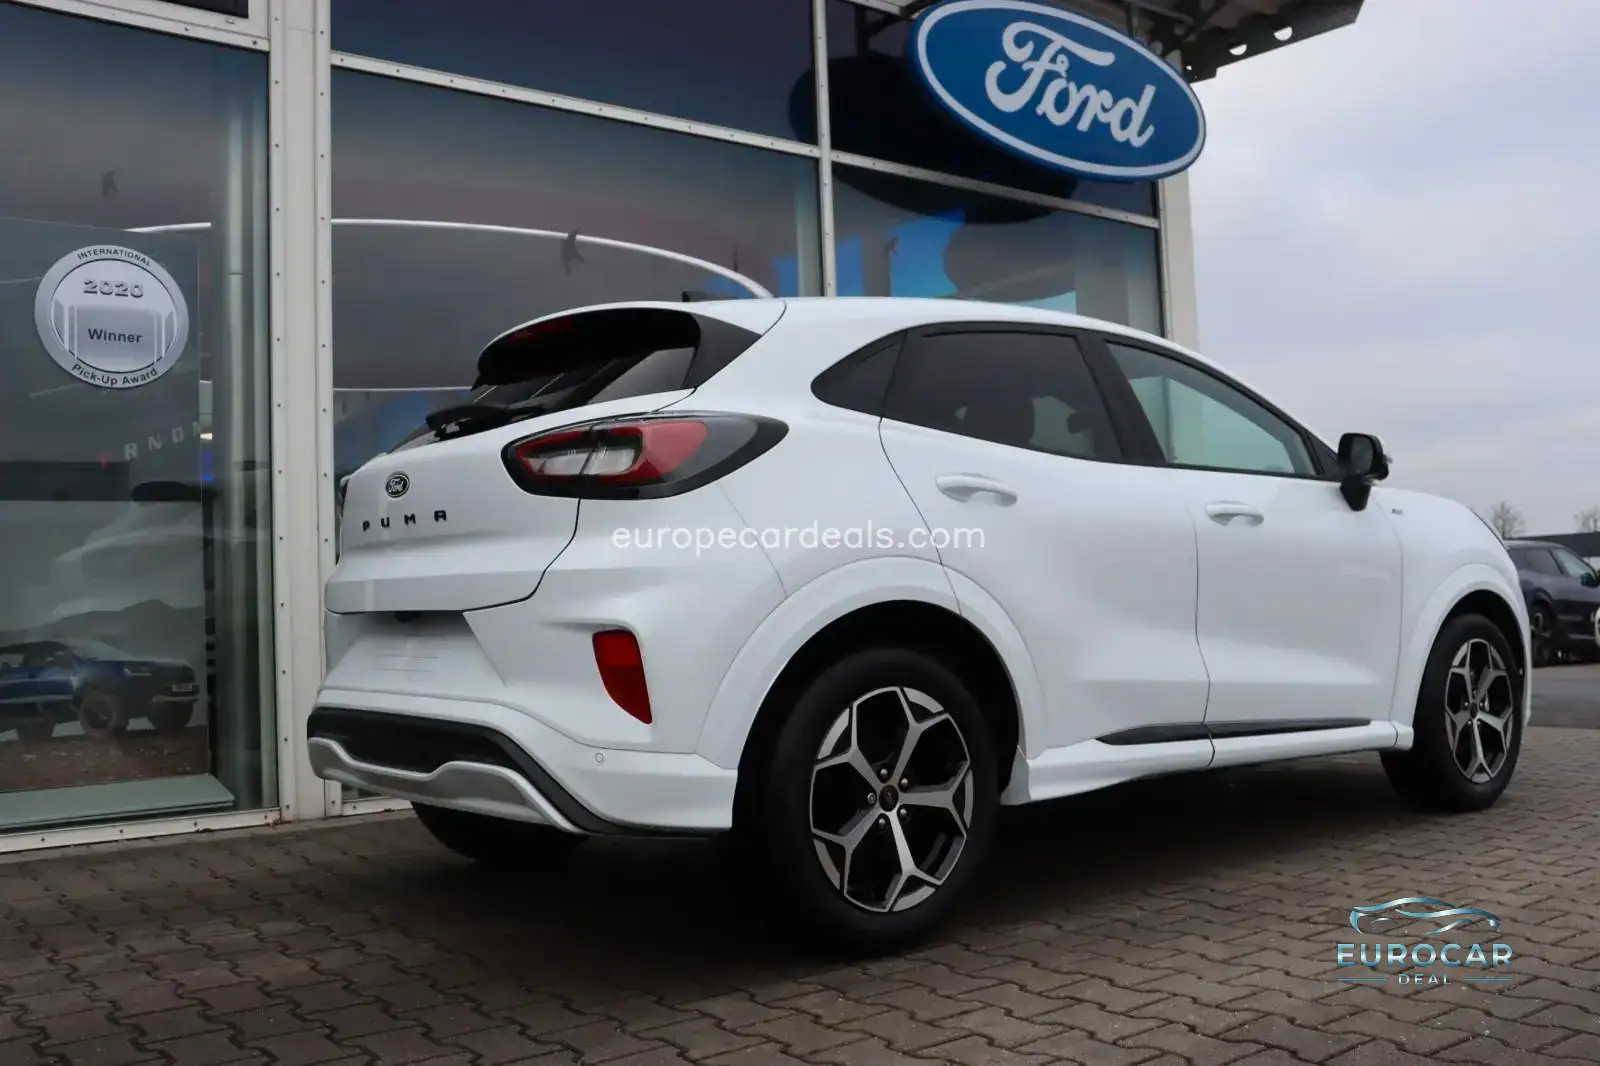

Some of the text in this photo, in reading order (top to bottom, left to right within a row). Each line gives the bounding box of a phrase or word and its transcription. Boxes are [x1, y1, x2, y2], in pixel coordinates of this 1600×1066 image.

[985, 21, 1156, 147] Ford
[77, 248, 153, 267] INTERNATIONAL
[83, 279, 144, 299] 2020
[87, 328, 143, 343] Winner
[71, 362, 158, 387] Pick-Up Award
[362, 509, 447, 532] PUMA
